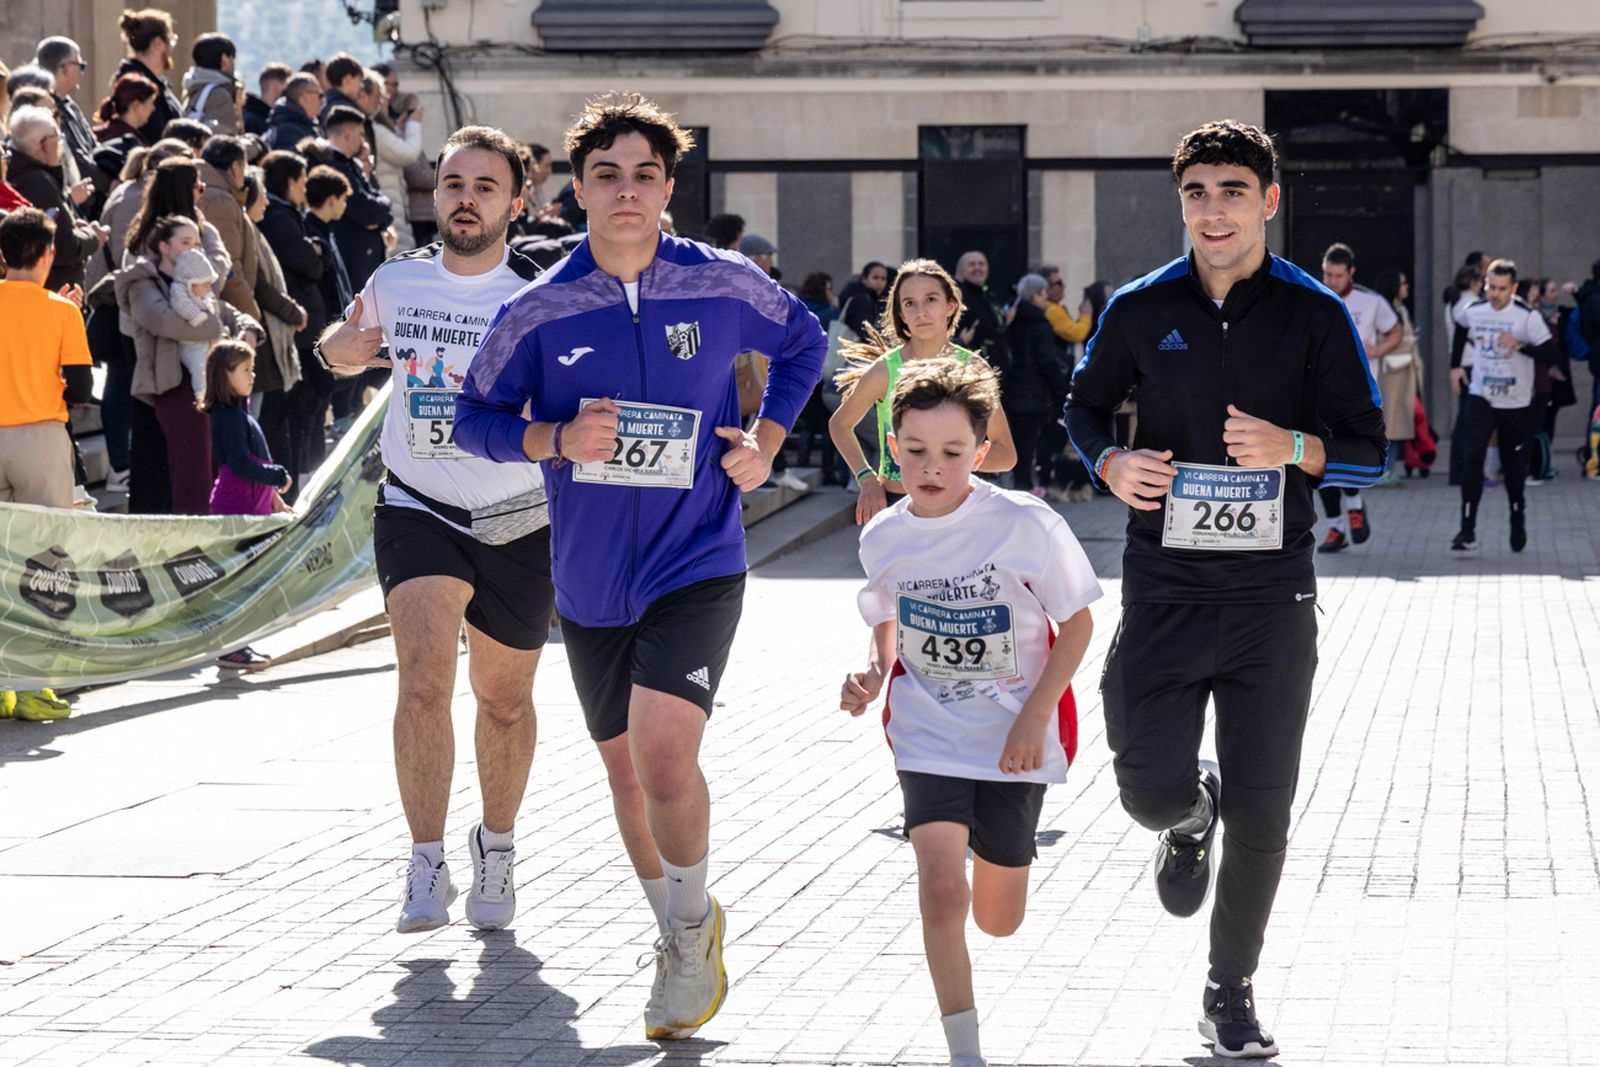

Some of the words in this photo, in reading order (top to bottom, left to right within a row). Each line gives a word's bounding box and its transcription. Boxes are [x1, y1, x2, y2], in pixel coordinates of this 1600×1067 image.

[397, 307, 405, 316] VI
[406, 307, 451, 322] CARRERA
[395, 322, 427, 340] BUENA
[431, 326, 481, 347] MUERTE
[418, 405, 442, 416] BUENA
[643, 411, 684, 420] CAMINATA
[627, 422, 665, 436] MUERTE
[603, 437, 669, 468] 267
[1183, 472, 1191, 480] VI
[1192, 472, 1229, 483] CARRERA
[1230, 474, 1270, 483] CAMINATA
[1182, 483, 1213, 498] BUENA
[1214, 486, 1252, 499] MUERTE
[1192, 500, 1256, 532] 266
[173, 558, 218, 585] ownat
[906, 578, 951, 592] CARRERA
[909, 602, 917, 610] VI
[918, 604, 952, 620] CARRERA
[952, 608, 997, 620] CAMINATA
[910, 613, 937, 632] BUENA
[939, 621, 978, 635] MUERTE
[921, 635, 986, 665] 439
